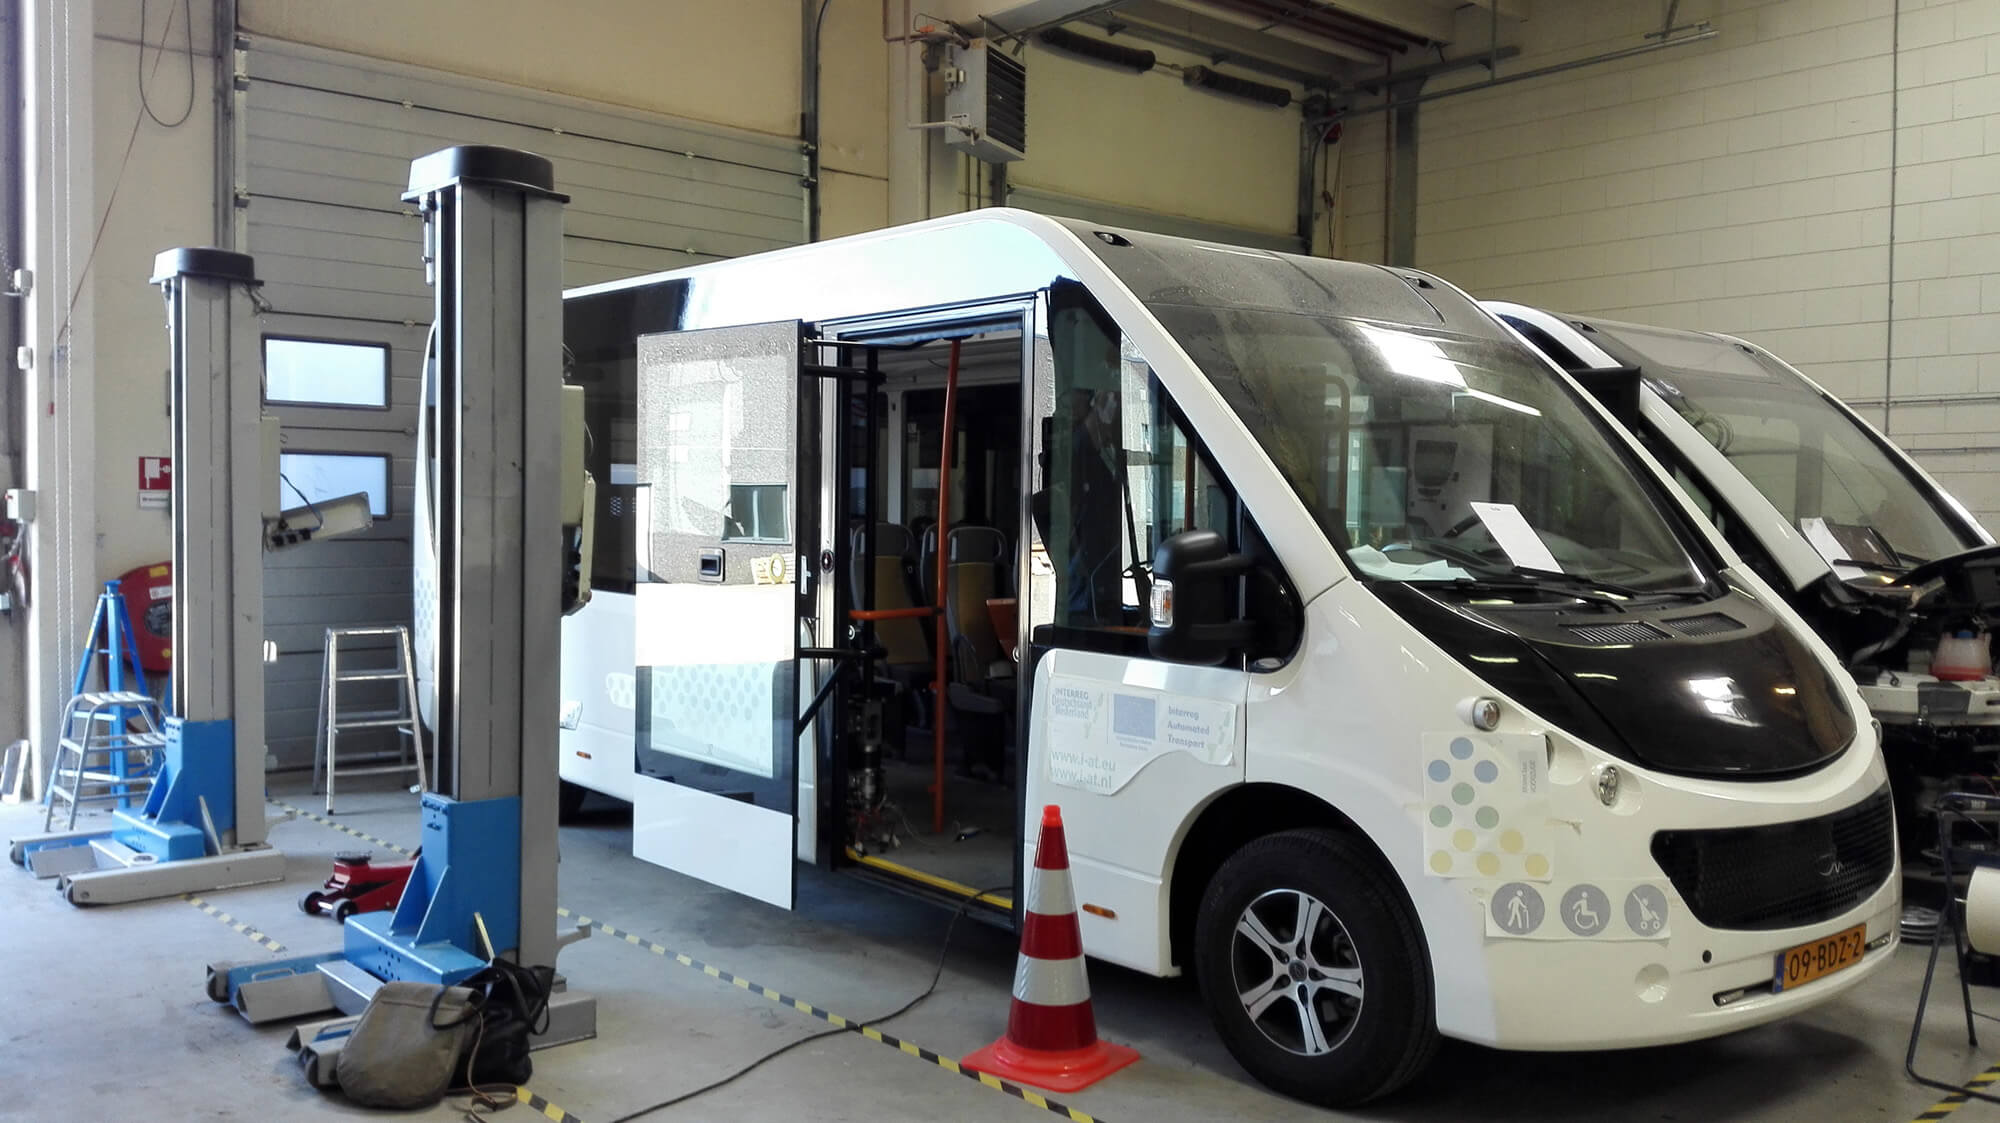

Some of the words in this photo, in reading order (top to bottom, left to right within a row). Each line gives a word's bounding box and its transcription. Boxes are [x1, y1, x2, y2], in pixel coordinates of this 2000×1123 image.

[1055, 687, 1089, 700] INTERREG
[1167, 719, 1210, 736] Automated
[1168, 733, 1205, 749] Transport
[1051, 750, 1116, 772] www.i-at.eu
[1788, 931, 1862, 982] 09-BDZ-2
